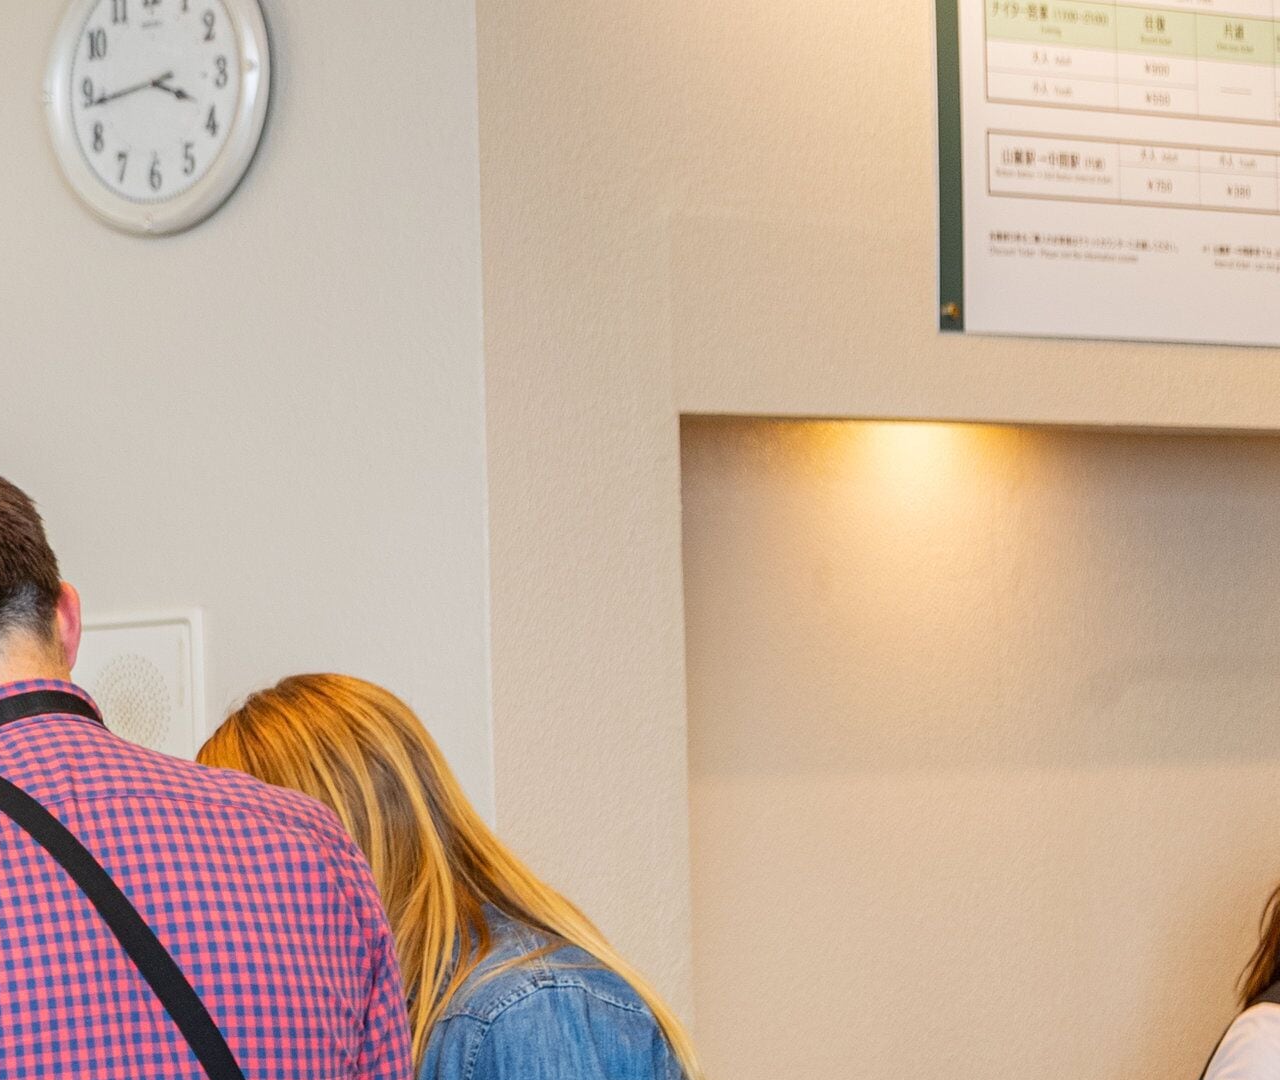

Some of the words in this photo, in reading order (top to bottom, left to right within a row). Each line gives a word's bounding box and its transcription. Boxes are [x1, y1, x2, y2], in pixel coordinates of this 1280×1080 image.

[203, 9, 215, 42] 2
[89, 28, 107, 60] 10
[205, 105, 218, 138] 4
[117, 151, 128, 183] 7
[149, 151, 162, 191] 6
[184, 142, 196, 176] 5
